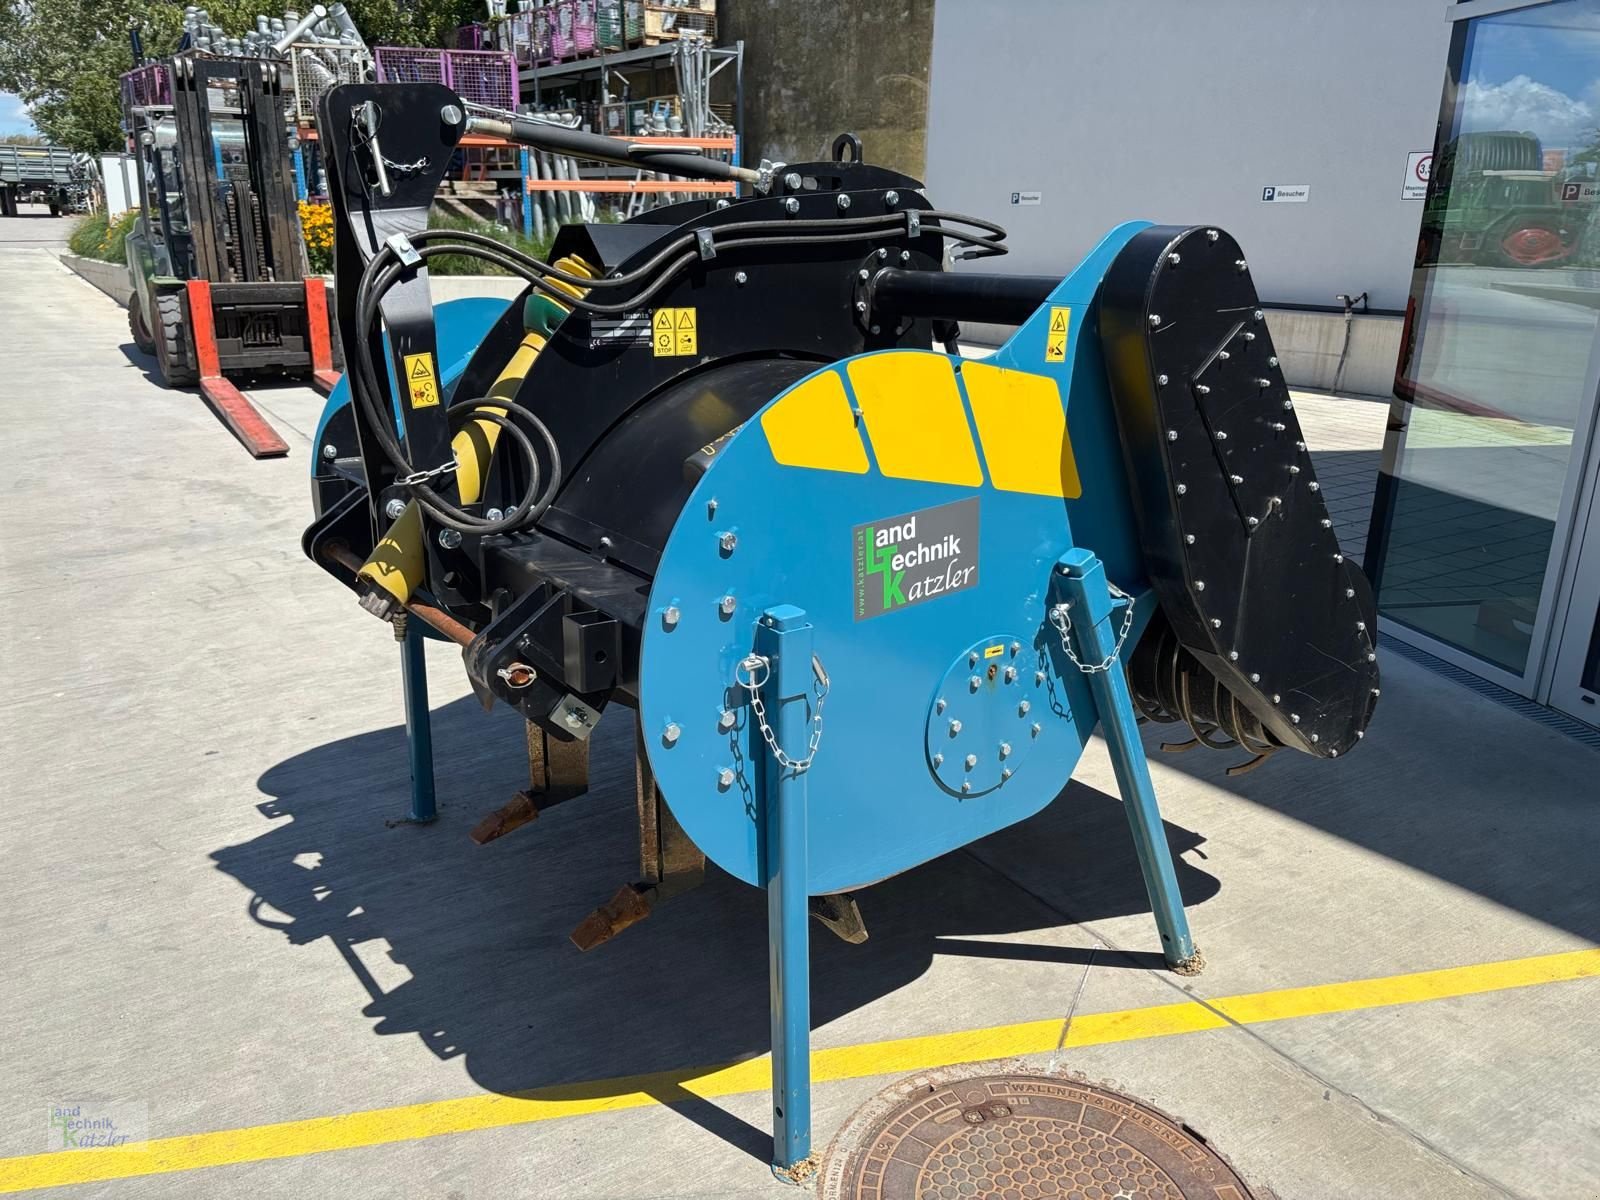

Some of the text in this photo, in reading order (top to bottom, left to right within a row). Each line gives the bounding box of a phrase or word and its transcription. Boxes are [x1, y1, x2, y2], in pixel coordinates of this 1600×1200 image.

[1264, 188, 1273, 200] P
[1566, 185, 1576, 198] P
[876, 534, 961, 572] Technik
[856, 530, 864, 616] www.katzler.at
[883, 558, 976, 609] Katzler
[1012, 1084, 1088, 1100] WALLNER
[1094, 1098, 1104, 1106] &
